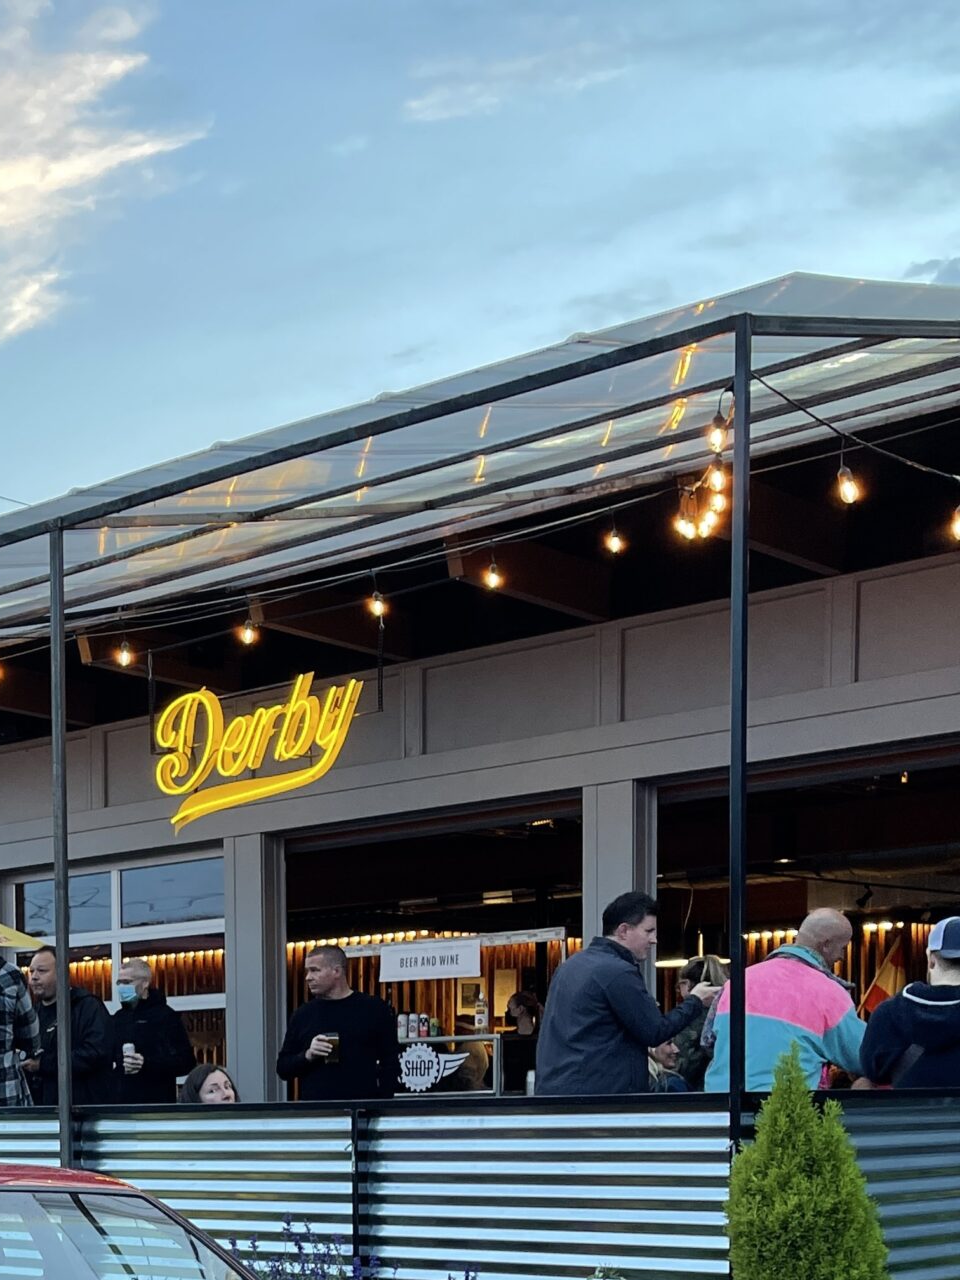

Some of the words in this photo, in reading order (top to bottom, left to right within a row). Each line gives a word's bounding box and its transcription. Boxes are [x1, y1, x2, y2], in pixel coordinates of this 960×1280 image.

[156, 671, 364, 836] Derby
[399, 956, 418, 969] BEER
[420, 955, 437, 967] AND
[439, 953, 460, 966] WINE
[404, 1059, 434, 1077] SHOP
